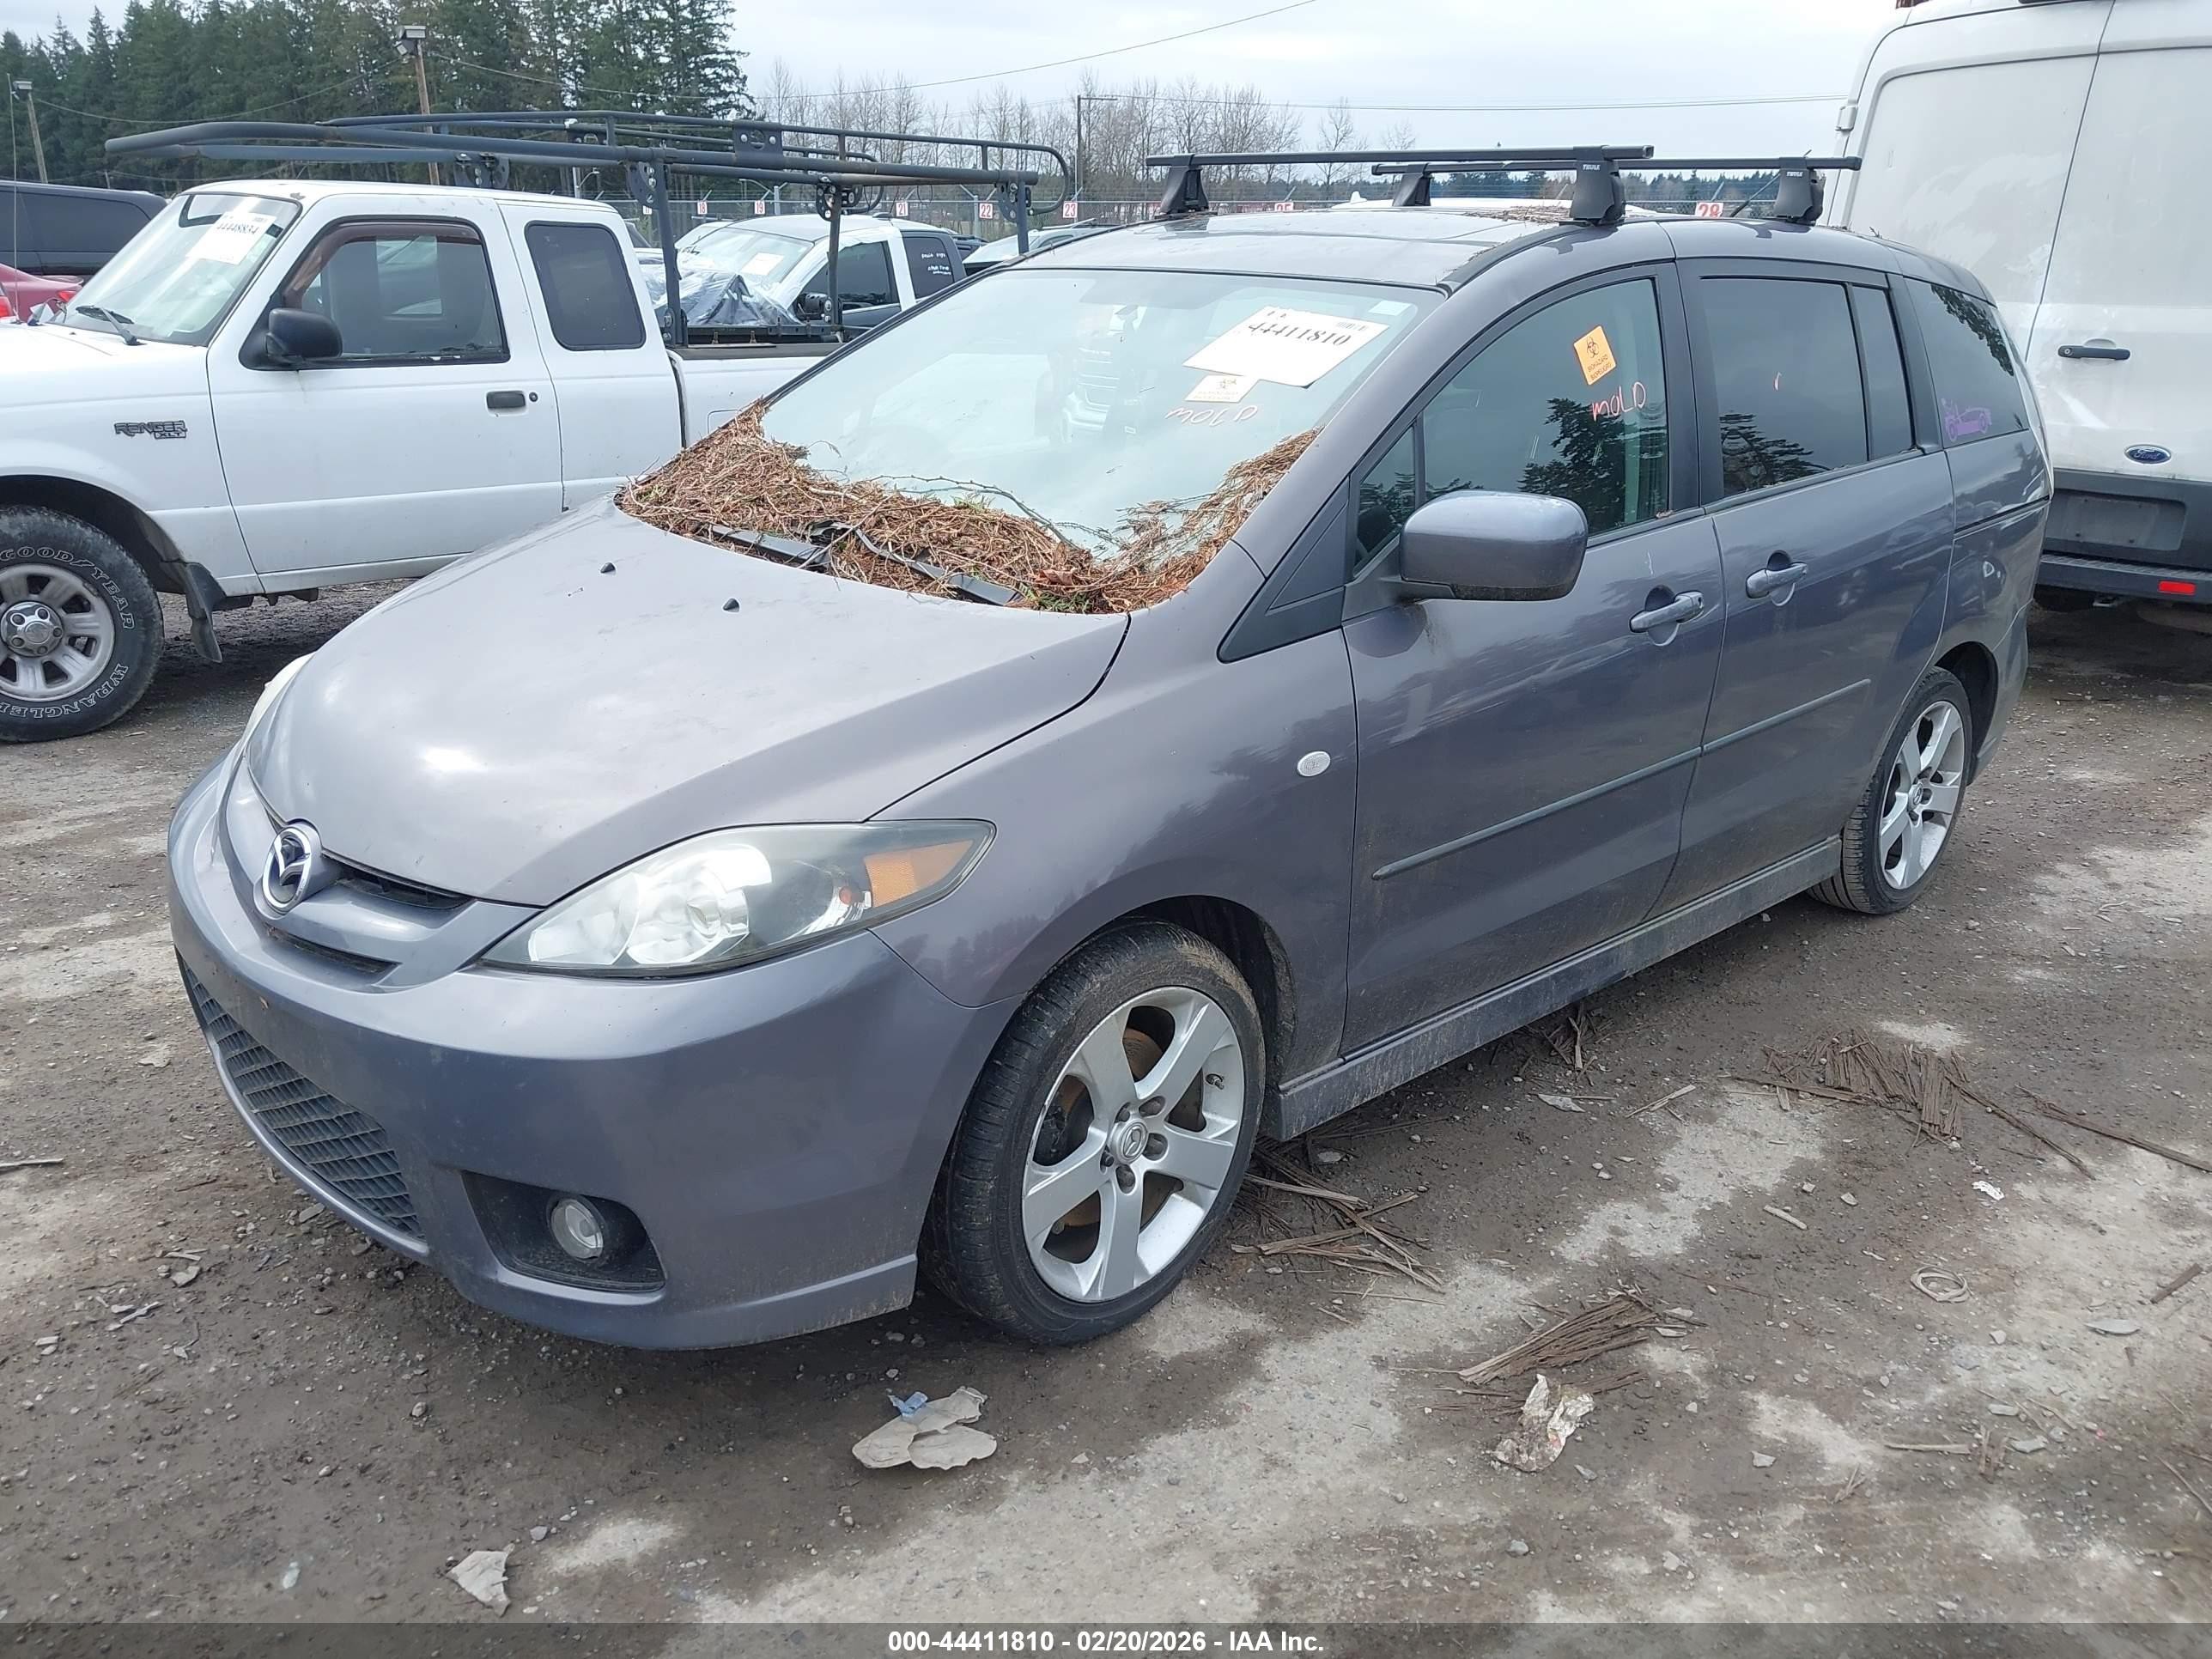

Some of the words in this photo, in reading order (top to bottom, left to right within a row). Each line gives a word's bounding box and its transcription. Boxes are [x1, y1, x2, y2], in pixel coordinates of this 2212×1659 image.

[699, 203, 706, 214] 18
[756, 203, 763, 214] 19
[897, 203, 907, 215] 21
[981, 204, 992, 216] 22
[1065, 204, 1077, 216] 23
[1248, 322, 1352, 345] 44411810
[113, 420, 188, 437] RANGER
[2133, 448, 2161, 461] Ford
